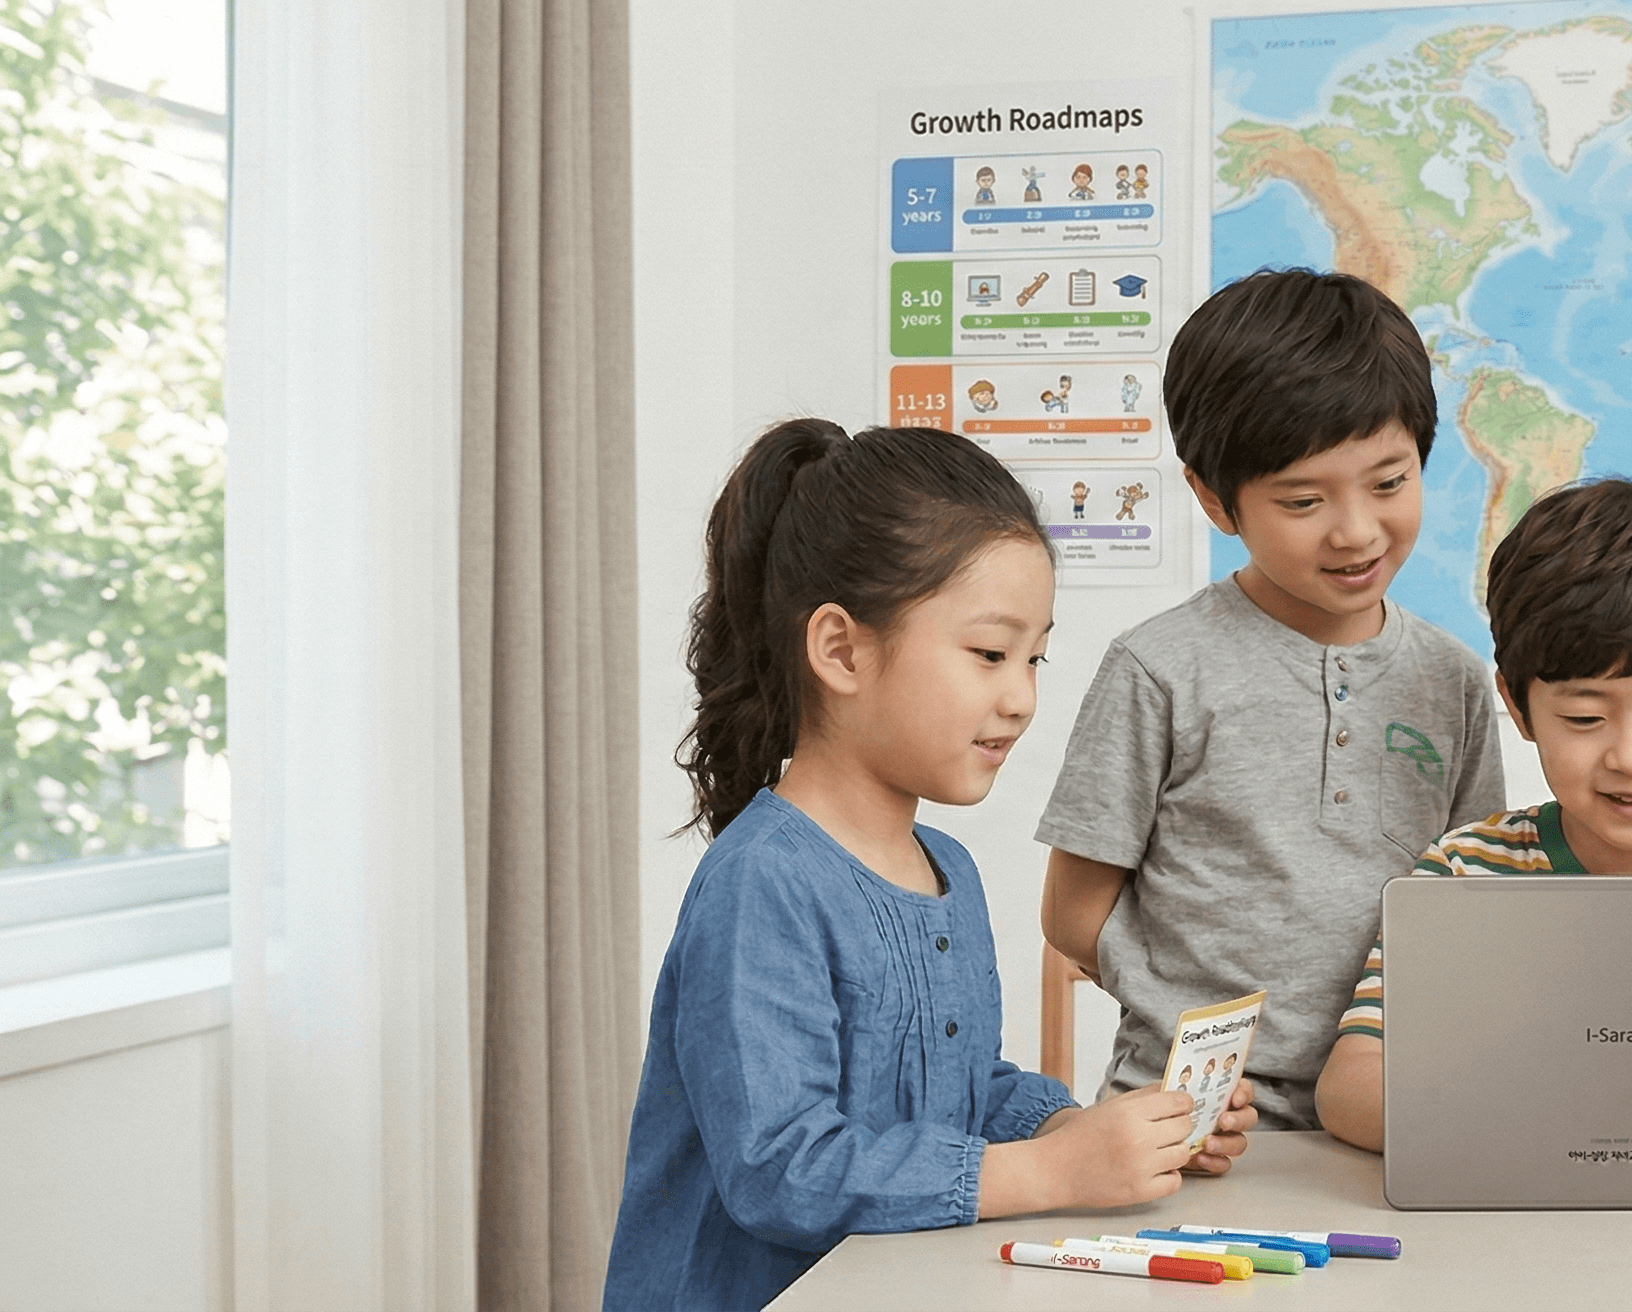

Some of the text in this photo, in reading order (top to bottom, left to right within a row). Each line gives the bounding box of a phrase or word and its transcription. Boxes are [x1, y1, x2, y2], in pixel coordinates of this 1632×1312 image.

[910, 104, 1144, 135] Growth Roadmaps
[906, 187, 937, 206] 5-7
[902, 210, 942, 226] years
[901, 289, 943, 308] 8-10
[901, 314, 942, 329] years
[897, 393, 946, 411] 11-13
